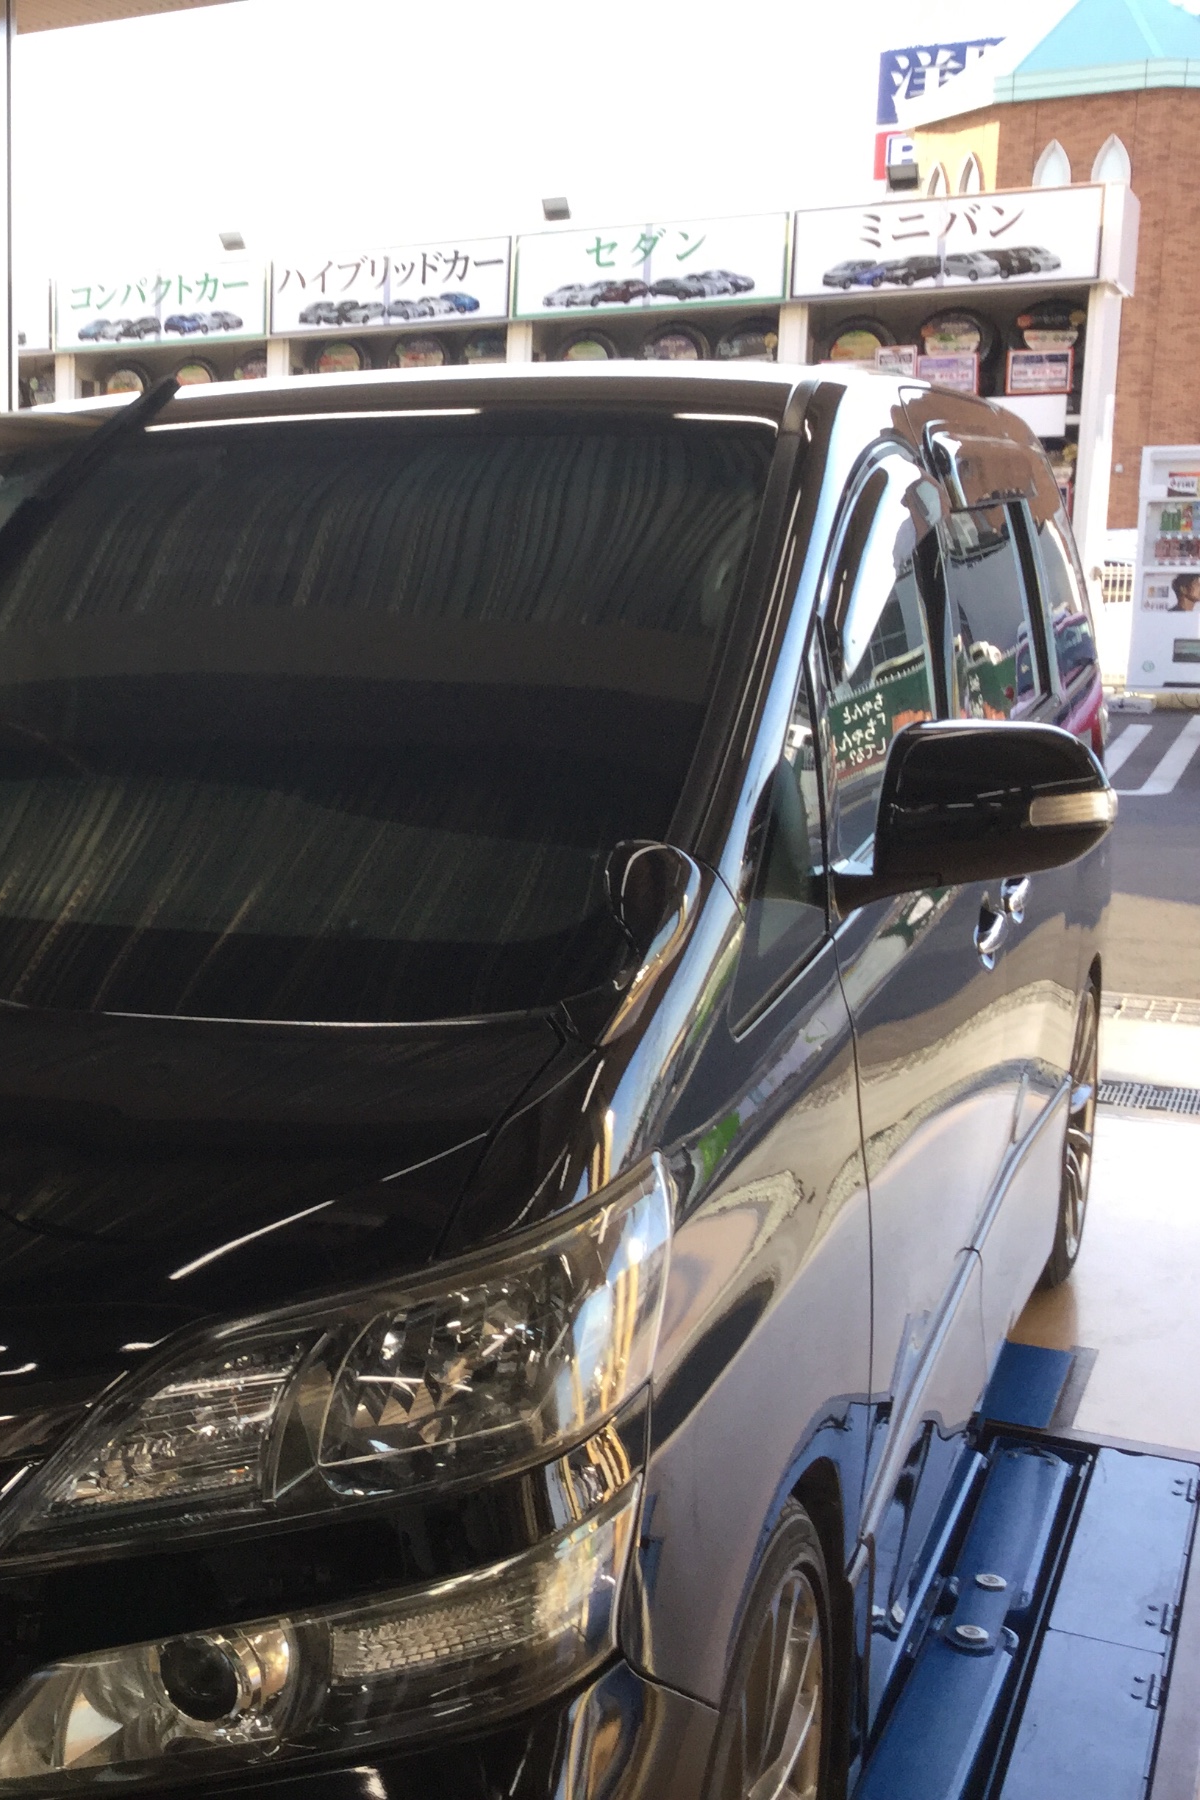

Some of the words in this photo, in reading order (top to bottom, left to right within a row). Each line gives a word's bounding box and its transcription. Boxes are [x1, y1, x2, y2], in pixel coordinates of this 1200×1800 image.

[859, 203, 1025, 248] ミニバン
[585, 227, 707, 268] セダン
[70, 272, 249, 310] コンパクトカー
[277, 249, 504, 294] ハイブリッドカー
